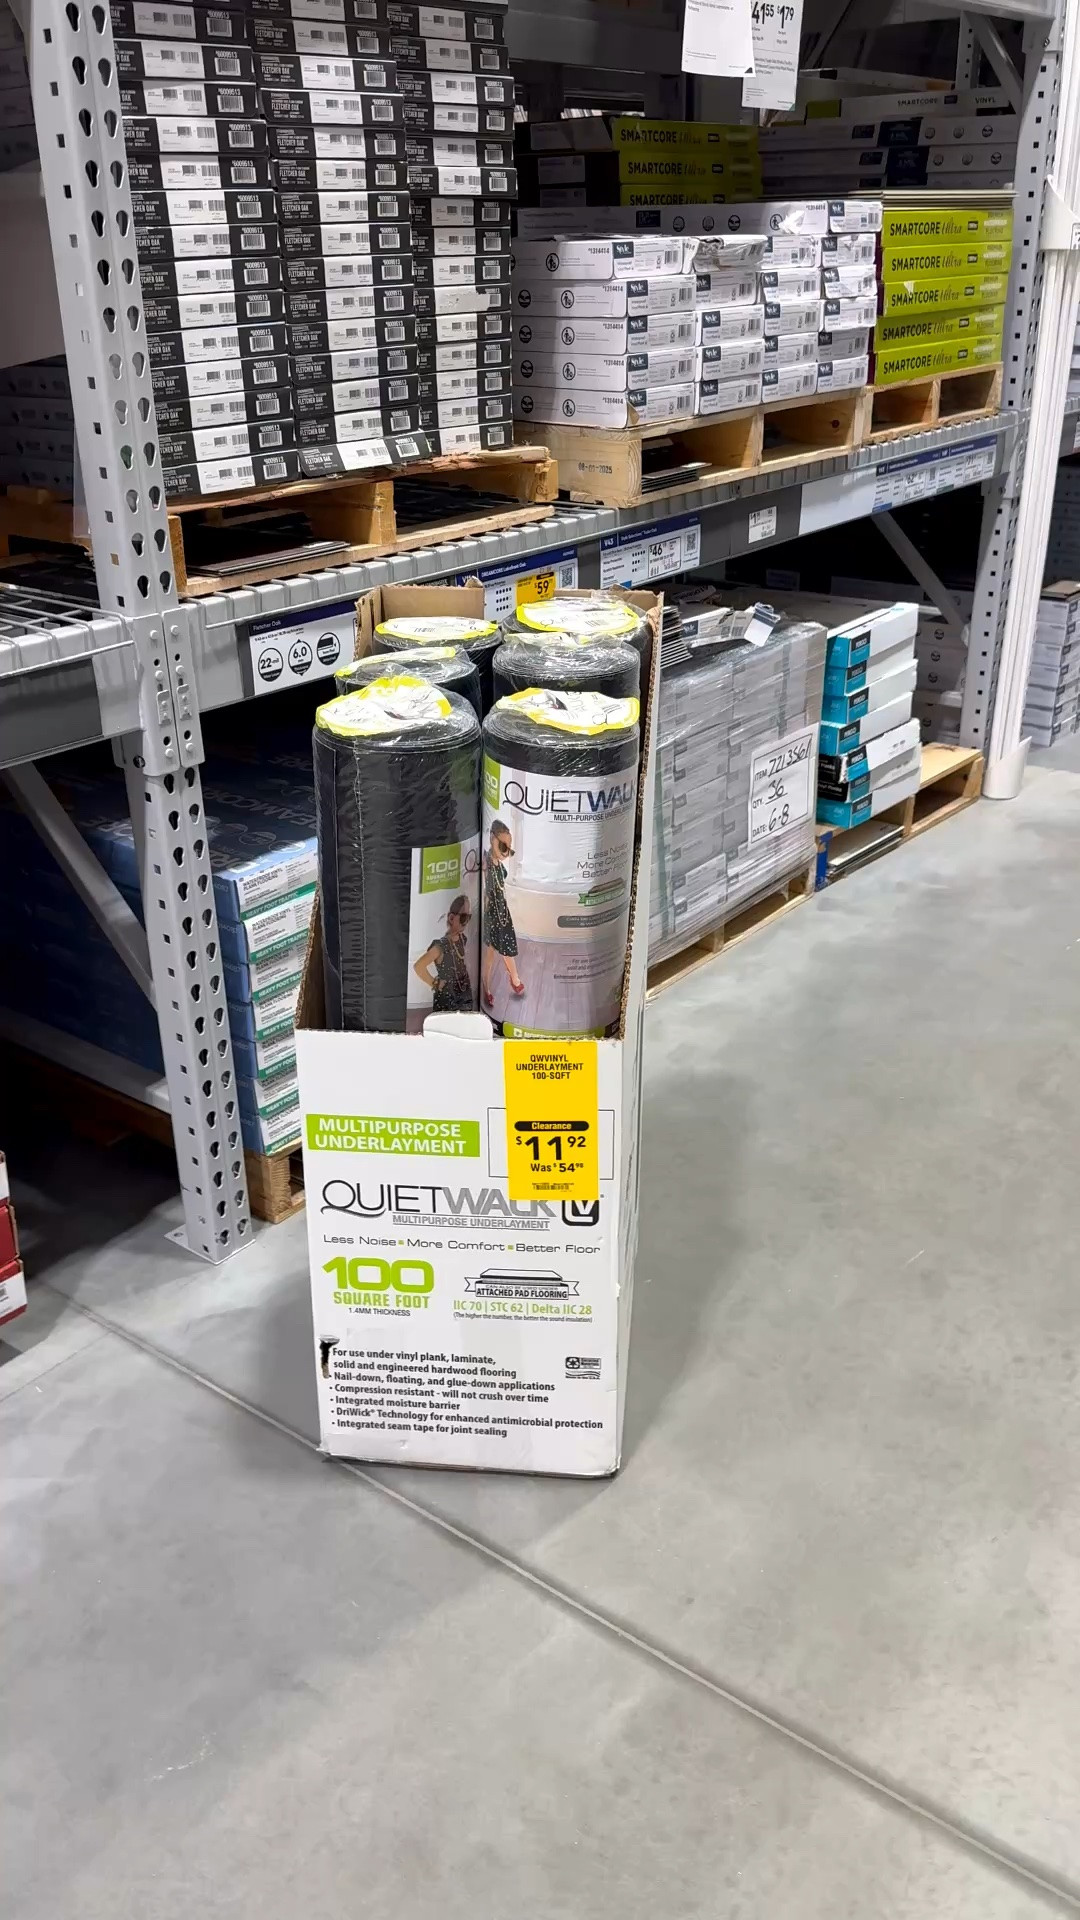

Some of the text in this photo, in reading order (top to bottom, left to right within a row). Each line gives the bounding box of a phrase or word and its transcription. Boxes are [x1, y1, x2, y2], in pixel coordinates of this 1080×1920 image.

[628, 162, 682, 175] SMARTCORE
[890, 221, 940, 236] SMARTCORE
[891, 255, 940, 271] SMARTCORE
[891, 290, 939, 307] SMARTCORE
[882, 322, 932, 341] SMARTCORE
[883, 354, 932, 374] SMARTCORE
[293, 646, 307, 659] 6.0
[427, 858, 458, 874] 100
[530, 1054, 569, 1063] QWVINYL
[516, 1063, 584, 1071] UNDERLAYMENT
[531, 1071, 571, 1080] 100-SQFT
[319, 1117, 461, 1138] MULTIPURPOSE
[531, 1122, 572, 1130] Clearance
[315, 1134, 467, 1154] UNDERLAYMENT
[530, 1163, 552, 1172] Was
[393, 1215, 550, 1229] MULTIPURPOSE UNDERLAYMENT
[323, 1234, 601, 1254] Less Noise More Comfort Better Floor
[322, 1256, 435, 1294] 100
[333, 1291, 431, 1309] SQUARE FOOT
[476, 1288, 567, 1299] ATTACHED PAD FLOORING
[348, 1307, 411, 1317] 1.4MM THICKNESS
[469, 1300, 482, 1311] 70
[490, 1301, 508, 1312] STC
[510, 1302, 523, 1313] 62
[532, 1303, 560, 1314] Delta
[579, 1304, 592, 1315] 28
[332, 1347, 347, 1356] For
[366, 1350, 394, 1359] under
[396, 1351, 418, 1362] vinyl
[420, 1352, 449, 1363] plank,
[451, 1354, 496, 1365] laminate,
[333, 1360, 516, 1379] solid and engineered hardwood flooring
[334, 1371, 555, 1391] Nail-down, floating, and glue-down applications
[334, 1384, 392, 1395] Compression
[394, 1387, 435, 1397] resistant
[442, 1389, 459, 1398] will
[460, 1391, 477, 1400] not
[478, 1392, 503, 1401] crush
[505, 1394, 525, 1402] over
[527, 1394, 549, 1403] time
[335, 1396, 460, 1410] Integrated moisture barrier
[377, 1409, 428, 1421] Technology
[430, 1412, 443, 1421] for
[445, 1413, 490, 1424] enhanced
[491, 1416, 553, 1427] antimicrobial
[554, 1419, 603, 1429] protection
[337, 1419, 508, 1438] Integrated seam tape for joint sealing
